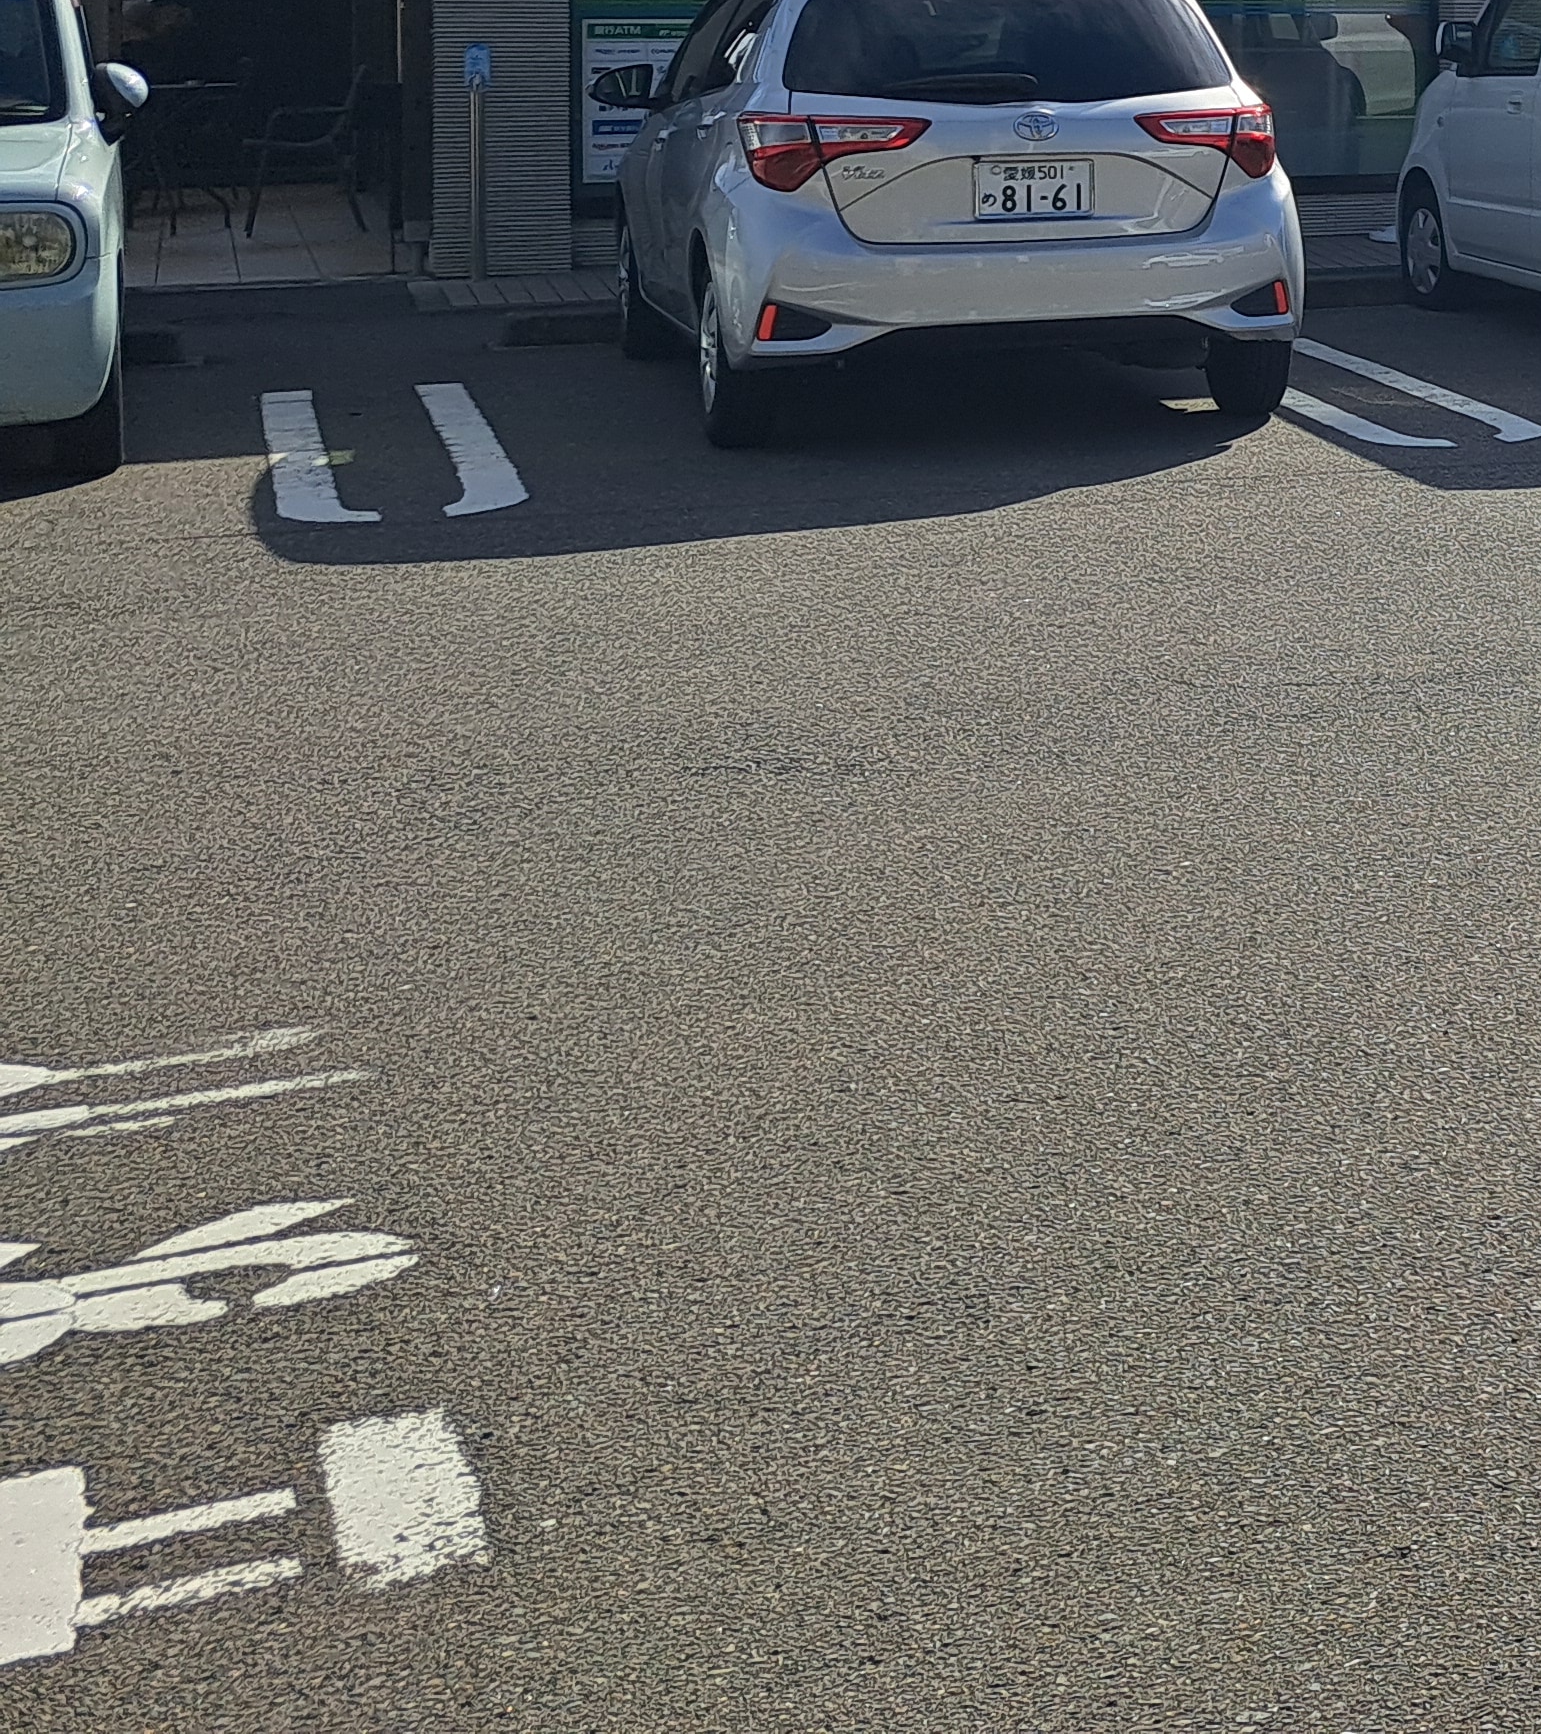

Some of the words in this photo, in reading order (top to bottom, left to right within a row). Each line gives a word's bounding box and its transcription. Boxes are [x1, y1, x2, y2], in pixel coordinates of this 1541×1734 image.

[1002, 166, 1065, 182] 愛媛501
[981, 192, 998, 208] め
[1001, 183, 1083, 213] 81-61
